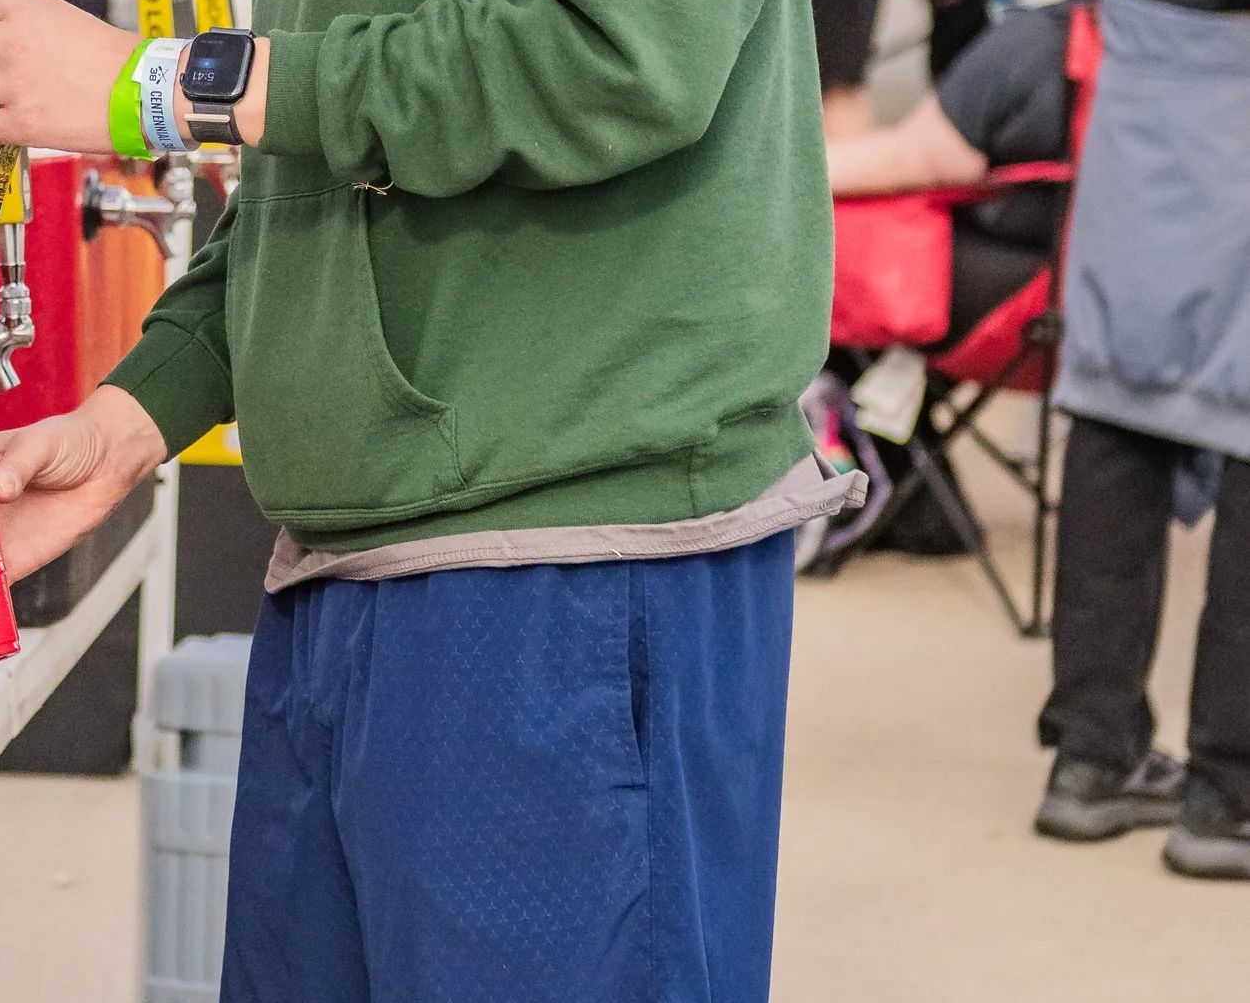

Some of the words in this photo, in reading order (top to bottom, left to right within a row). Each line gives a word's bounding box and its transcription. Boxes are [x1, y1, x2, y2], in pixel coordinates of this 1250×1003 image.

[149, 67, 158, 82] 38
[192, 72, 215, 82] 5:41
[150, 90, 171, 142] CENTENNIAL
